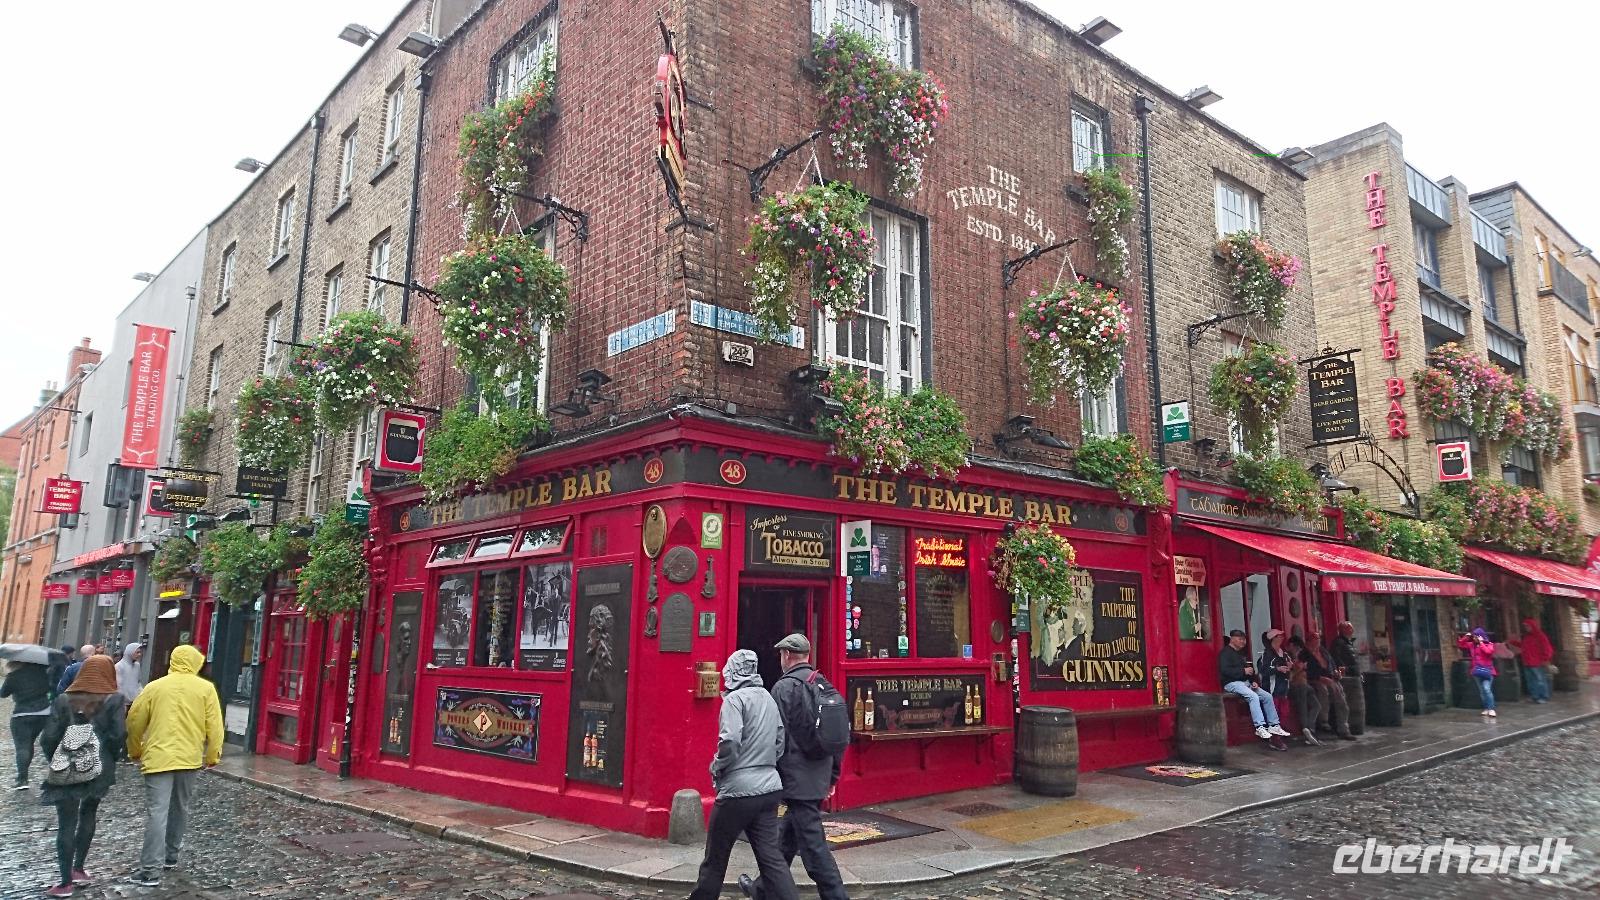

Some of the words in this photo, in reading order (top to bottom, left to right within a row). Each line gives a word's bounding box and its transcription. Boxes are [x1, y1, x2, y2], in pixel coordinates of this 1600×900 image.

[987, 165, 1021, 195] THE
[1362, 171, 1387, 229] THE
[946, 186, 1018, 216] TEMPLE
[1024, 207, 1056, 246] BAR
[1371, 243, 1400, 360] TEMPLE
[718, 319, 743, 332] TEMPLE
[140, 351, 152, 373] BAR
[1324, 362, 1338, 370] THE
[1311, 366, 1354, 381] TEMPLE
[1320, 378, 1345, 389] BAR
[134, 375, 149, 419] TEMPLE
[1329, 396, 1354, 405] GARDEN
[147, 386, 159, 429] TRADING
[1386, 376, 1409, 439] BAR
[1316, 420, 1332, 428] LIVE
[1332, 417, 1354, 425] MUSIC
[1325, 425, 1346, 433] DAILY
[131, 421, 144, 443] THE
[178, 472, 203, 481] TEMPLE
[260, 475, 285, 483] MUSIC
[647, 463, 660, 479] 48
[724, 463, 740, 479] 48
[166, 493, 210, 503] DISTILLERY
[174, 500, 201, 508] STORE
[431, 504, 464, 526] THE
[474, 482, 553, 517] TEMPLE
[562, 469, 612, 501] BAR
[834, 474, 897, 504] THE
[908, 484, 1014, 518] TEMPLE
[1024, 501, 1072, 525] BAR
[750, 514, 788, 532] Importers
[783, 529, 797, 537] FINE
[797, 530, 824, 539] SMOKING
[760, 531, 824, 560] TOBACCO
[915, 537, 963, 551] Traditional
[773, 555, 798, 564] Always
[809, 558, 829, 567] Stock
[915, 551, 937, 565] Irish
[940, 552, 966, 567] Music
[1372, 580, 1388, 591] THE
[1388, 581, 1413, 592] TEMPLE
[1413, 582, 1425, 592] BAR
[1120, 587, 1136, 602] THE
[1101, 602, 1137, 618] EMPEROR
[1128, 620, 1136, 635] OF
[1081, 641, 1111, 658] MALTED
[1111, 636, 1140, 656] LIQUORS
[1062, 660, 1144, 683] GUINNESS
[876, 679, 899, 692] THE
[901, 679, 941, 692] TEMPLE
[943, 678, 963, 691] BAR
[910, 692, 932, 700] DUBLIN
[446, 713, 470, 725] POWERS
[496, 719, 526, 732] WHISKEY
